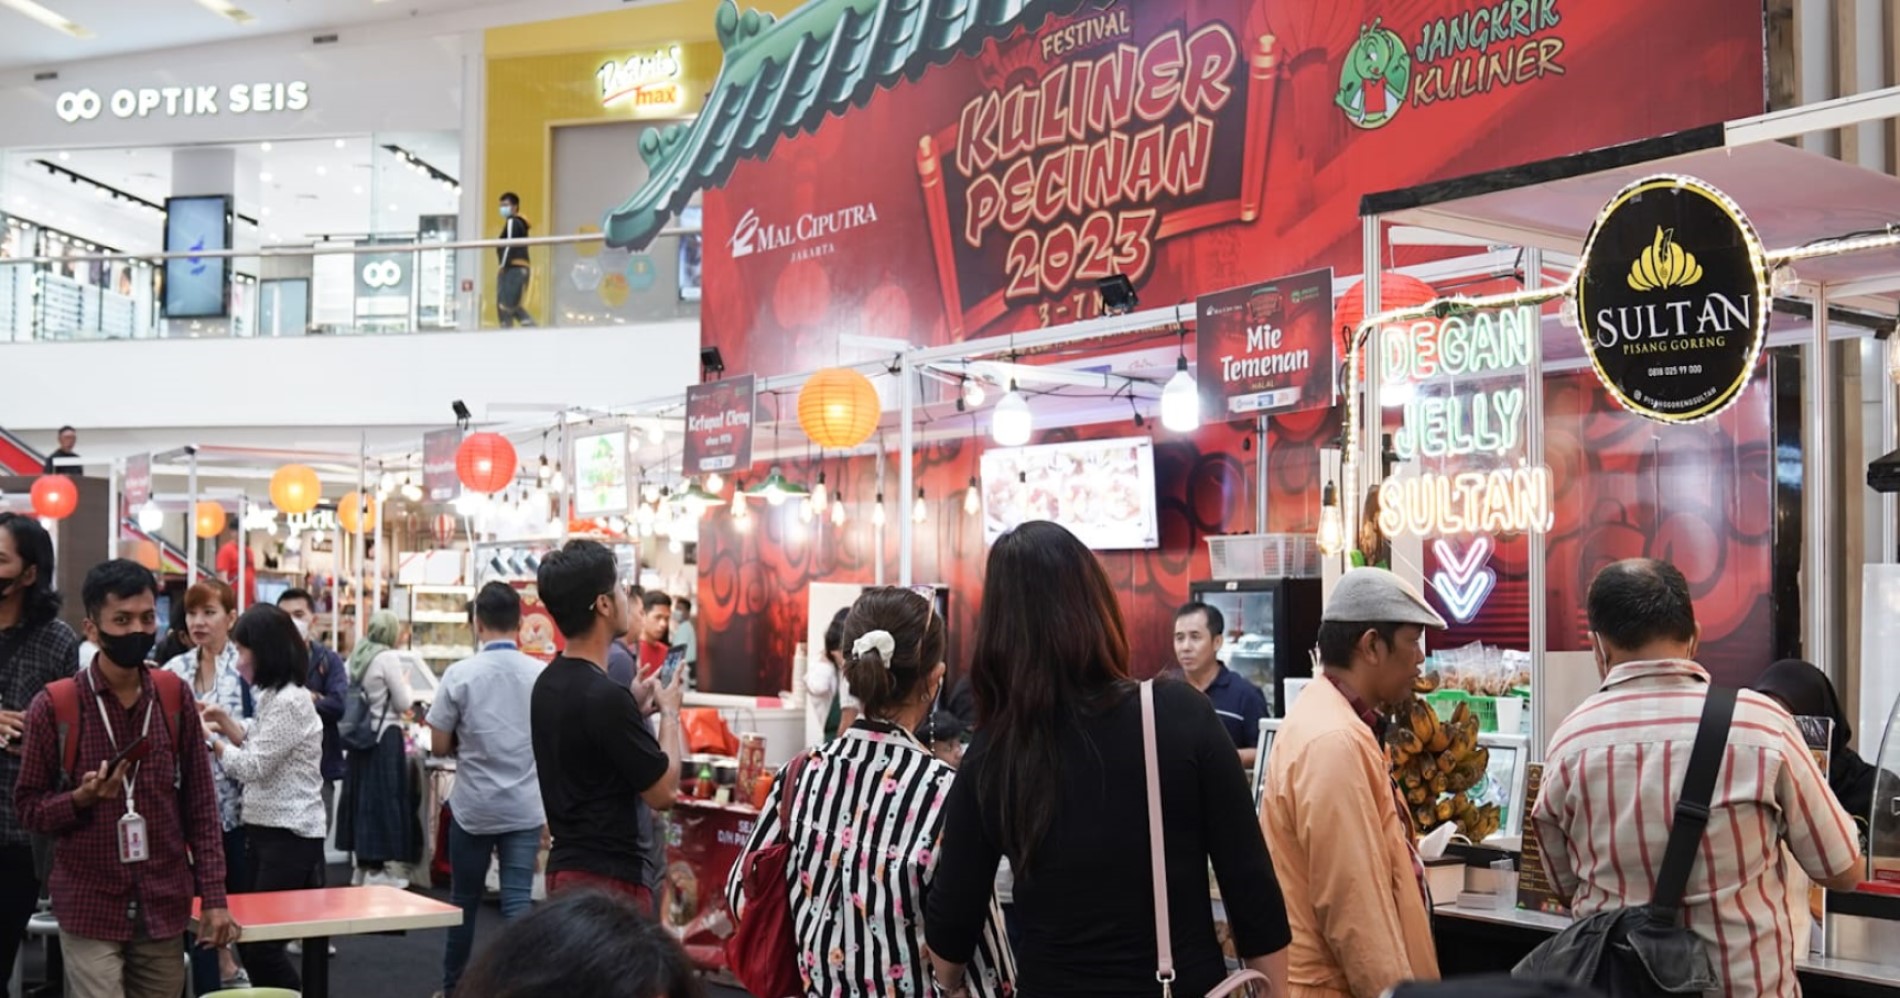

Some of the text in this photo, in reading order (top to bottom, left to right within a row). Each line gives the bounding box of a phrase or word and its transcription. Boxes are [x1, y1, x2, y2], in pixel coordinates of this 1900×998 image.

[1041, 11, 1130, 60] FESTIVAL
[1416, 0, 1560, 62] JANGKRIK
[110, 81, 308, 118] OPTIK SEIS
[956, 23, 1237, 177] KULINER
[1413, 38, 1565, 108] KULINER
[965, 116, 1214, 247] PECINAN
[757, 202, 878, 253] MAL CIPUTRA
[790, 243, 835, 263] JAKARTA
[1005, 208, 1156, 298] 2023
[1246, 323, 1281, 353] Mie
[1381, 306, 1532, 382] DEGAN
[1597, 292, 1751, 348] SULTAN
[1623, 336, 1726, 355] PISANG GORENG
[1220, 349, 1309, 382] Temenan
[1395, 388, 1523, 459] JELLY
